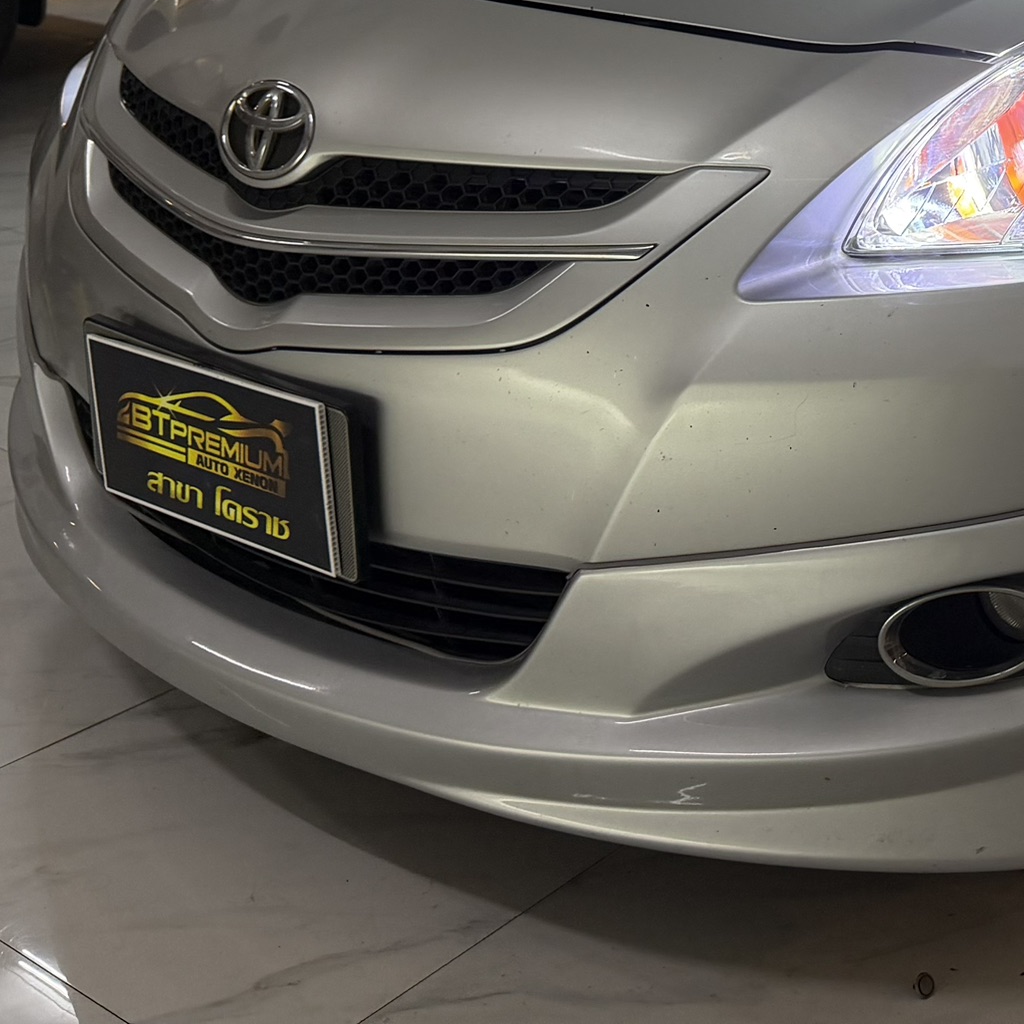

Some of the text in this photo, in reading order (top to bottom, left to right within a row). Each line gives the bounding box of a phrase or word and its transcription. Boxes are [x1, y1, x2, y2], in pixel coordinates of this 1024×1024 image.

[196, 454, 279, 493] AUTO XENON
[146, 470, 291, 541] สาขา โคราช
